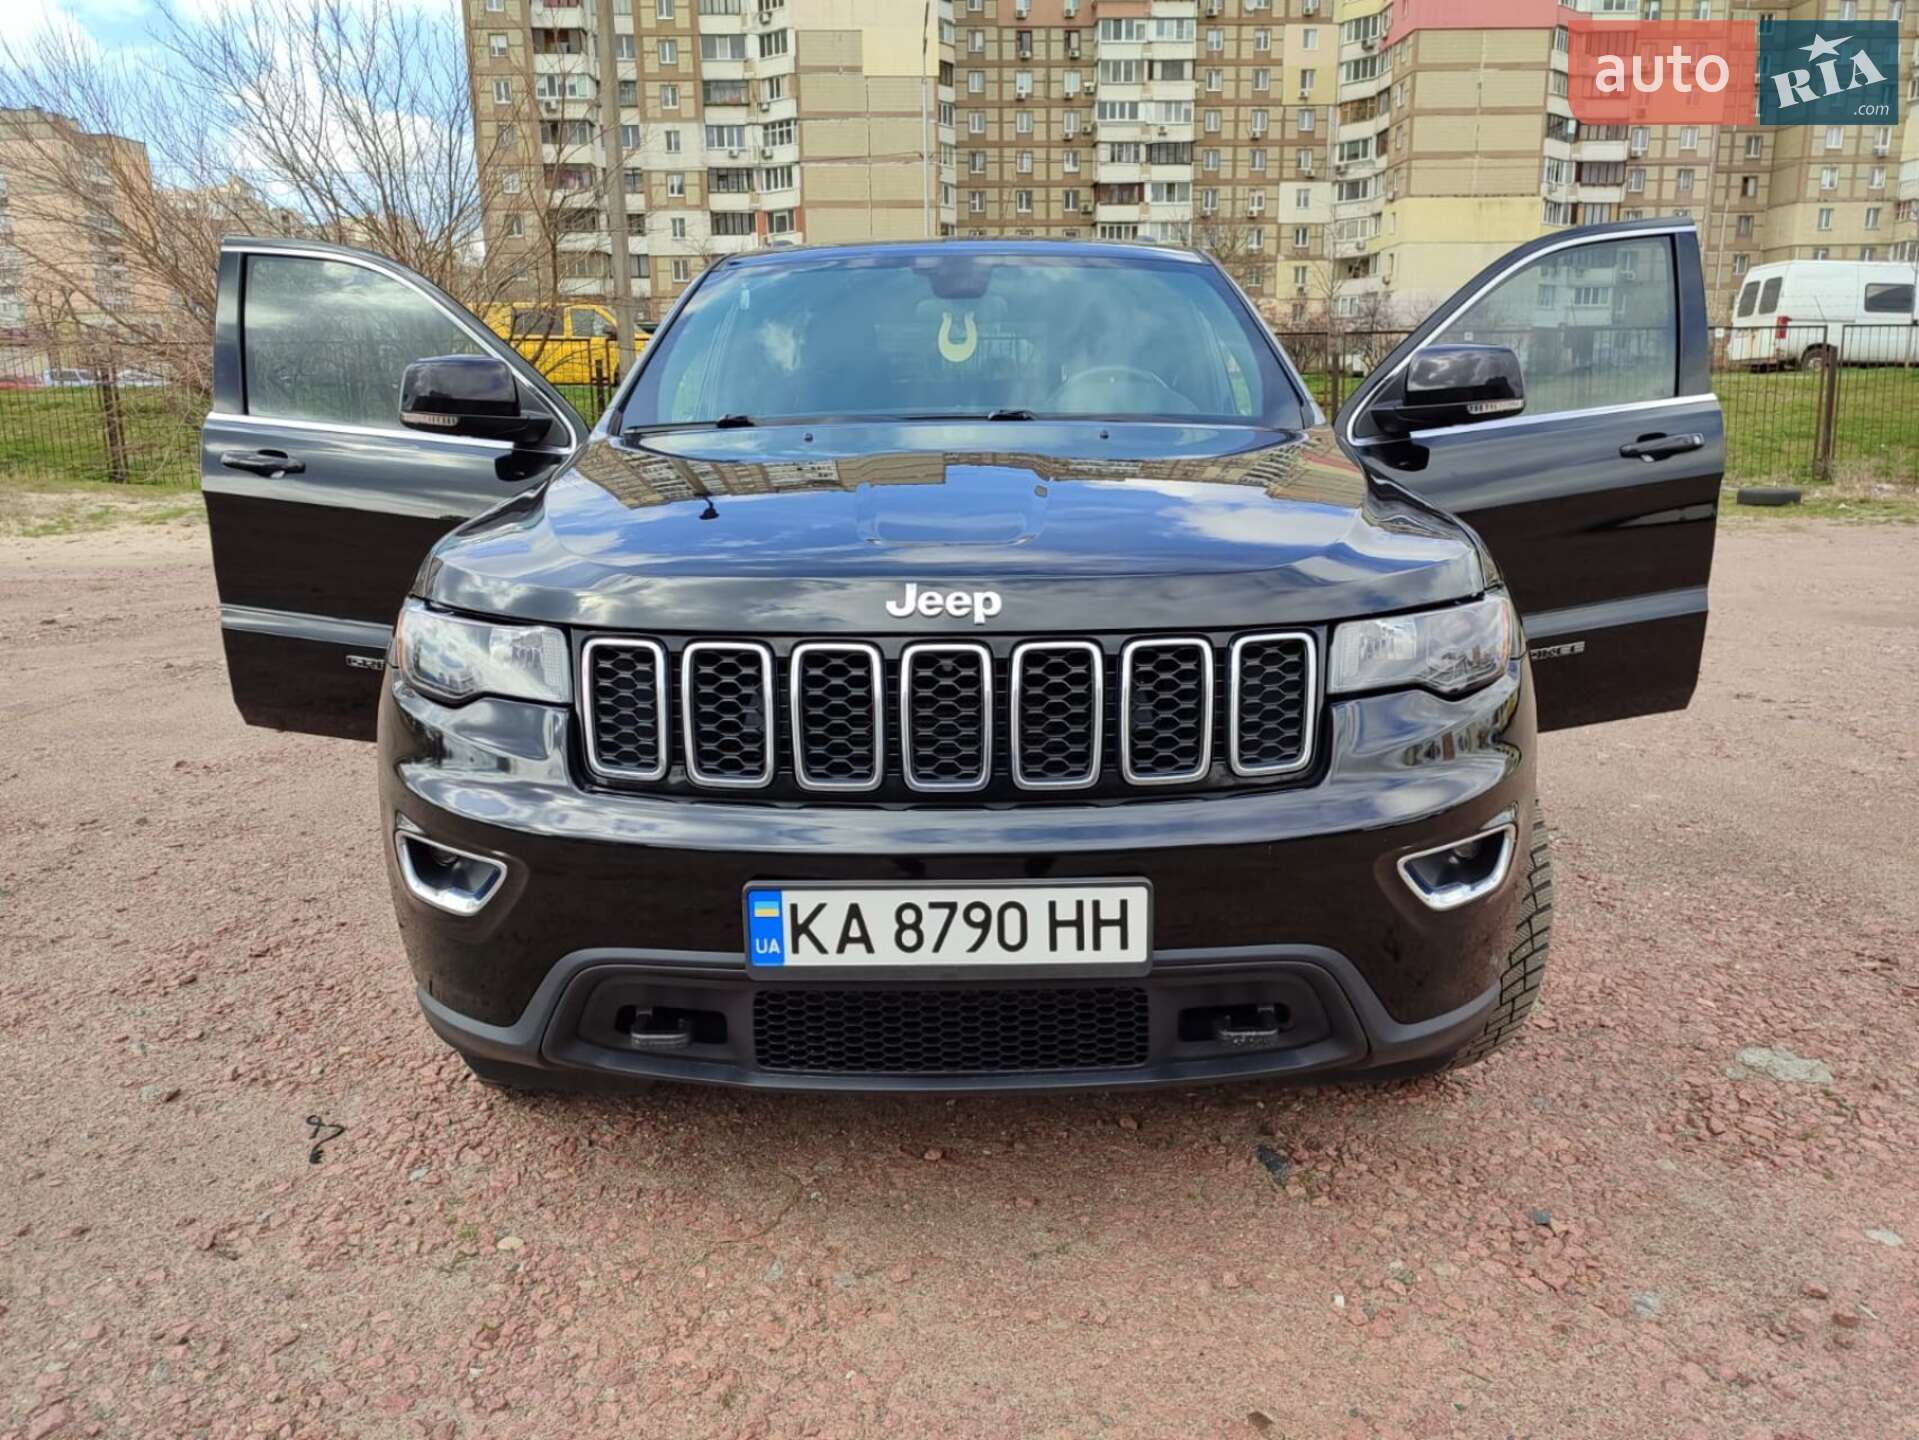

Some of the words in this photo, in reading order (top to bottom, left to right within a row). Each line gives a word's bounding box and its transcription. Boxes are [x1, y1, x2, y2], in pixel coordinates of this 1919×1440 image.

[886, 583, 1002, 624] Jeep
[755, 938, 780, 954] UA
[790, 902, 876, 954] KA
[894, 900, 1028, 953] 8790
[1048, 898, 1129, 952] HH
